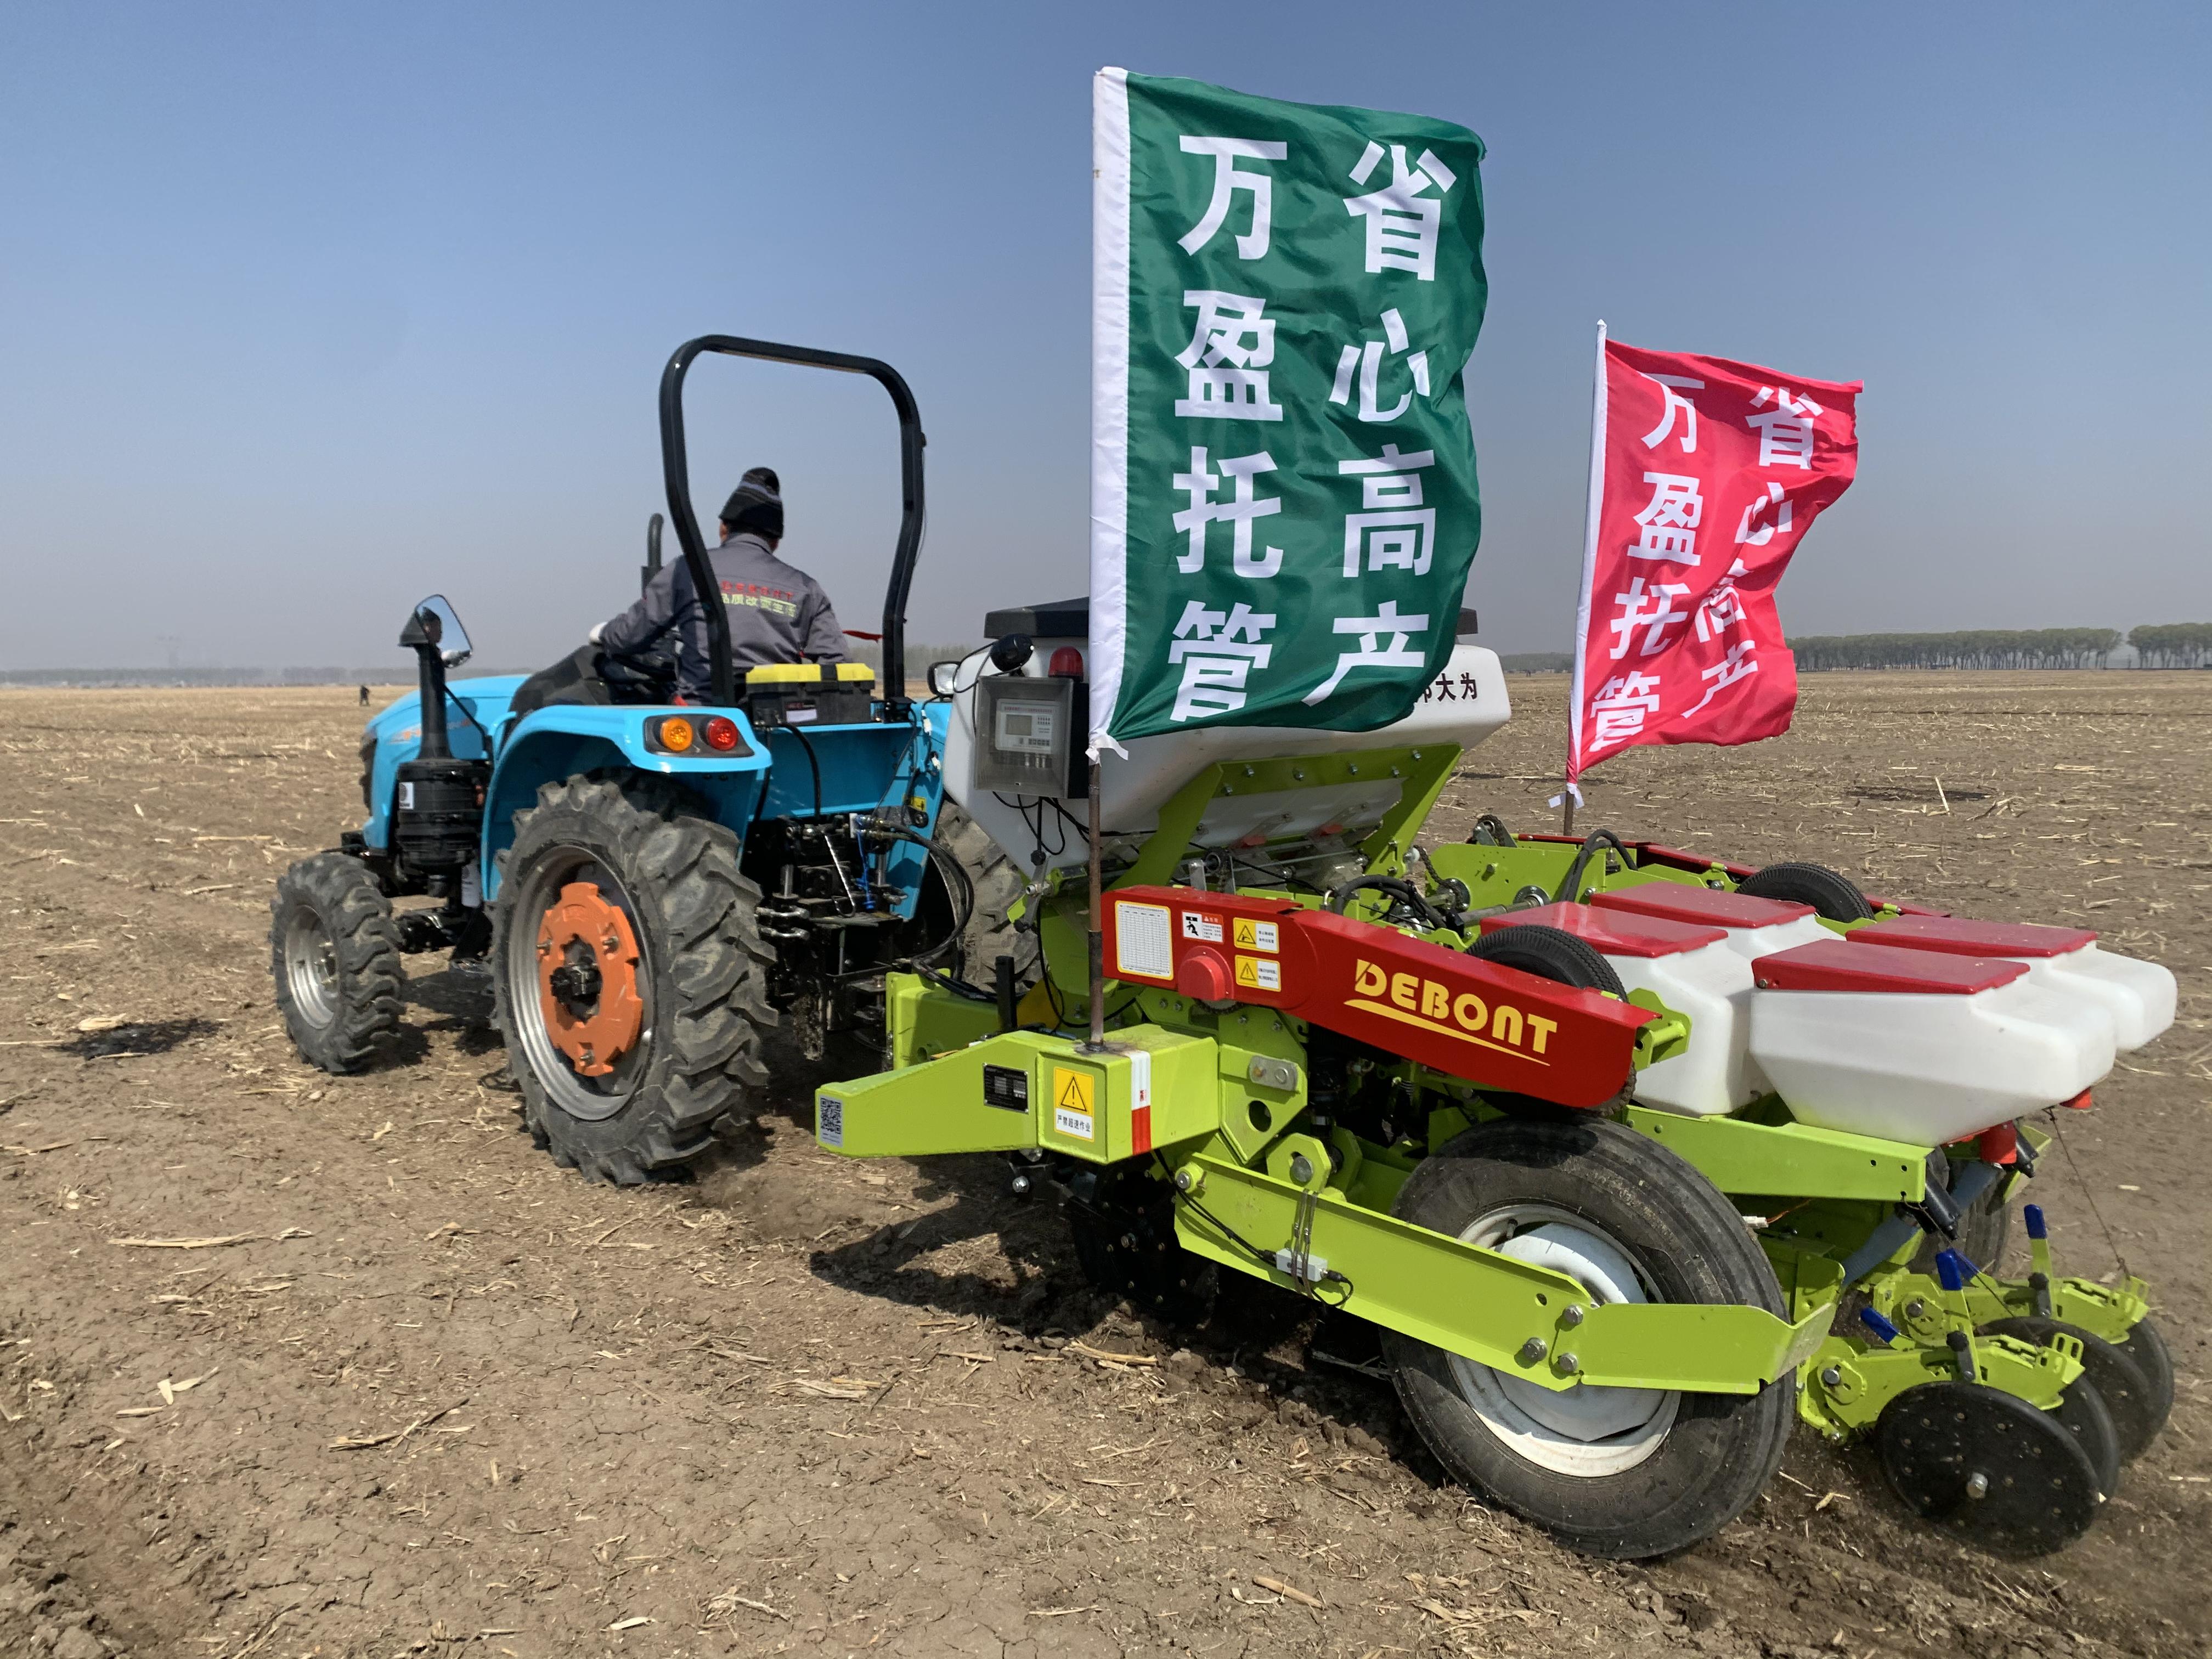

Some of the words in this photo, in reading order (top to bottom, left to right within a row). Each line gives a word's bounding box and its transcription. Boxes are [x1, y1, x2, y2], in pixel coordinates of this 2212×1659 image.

[1168, 135, 1288, 722] 万盈托管
[1301, 140, 1457, 707] 省心高产
[1589, 370, 1705, 752] 万盈托管
[1680, 386, 1824, 719] 省心高产
[1424, 672, 1477, 703] 大为
[1057, 1114, 1091, 1132] 严禁超速作业
[1355, 958, 1558, 1054] DEBONT
